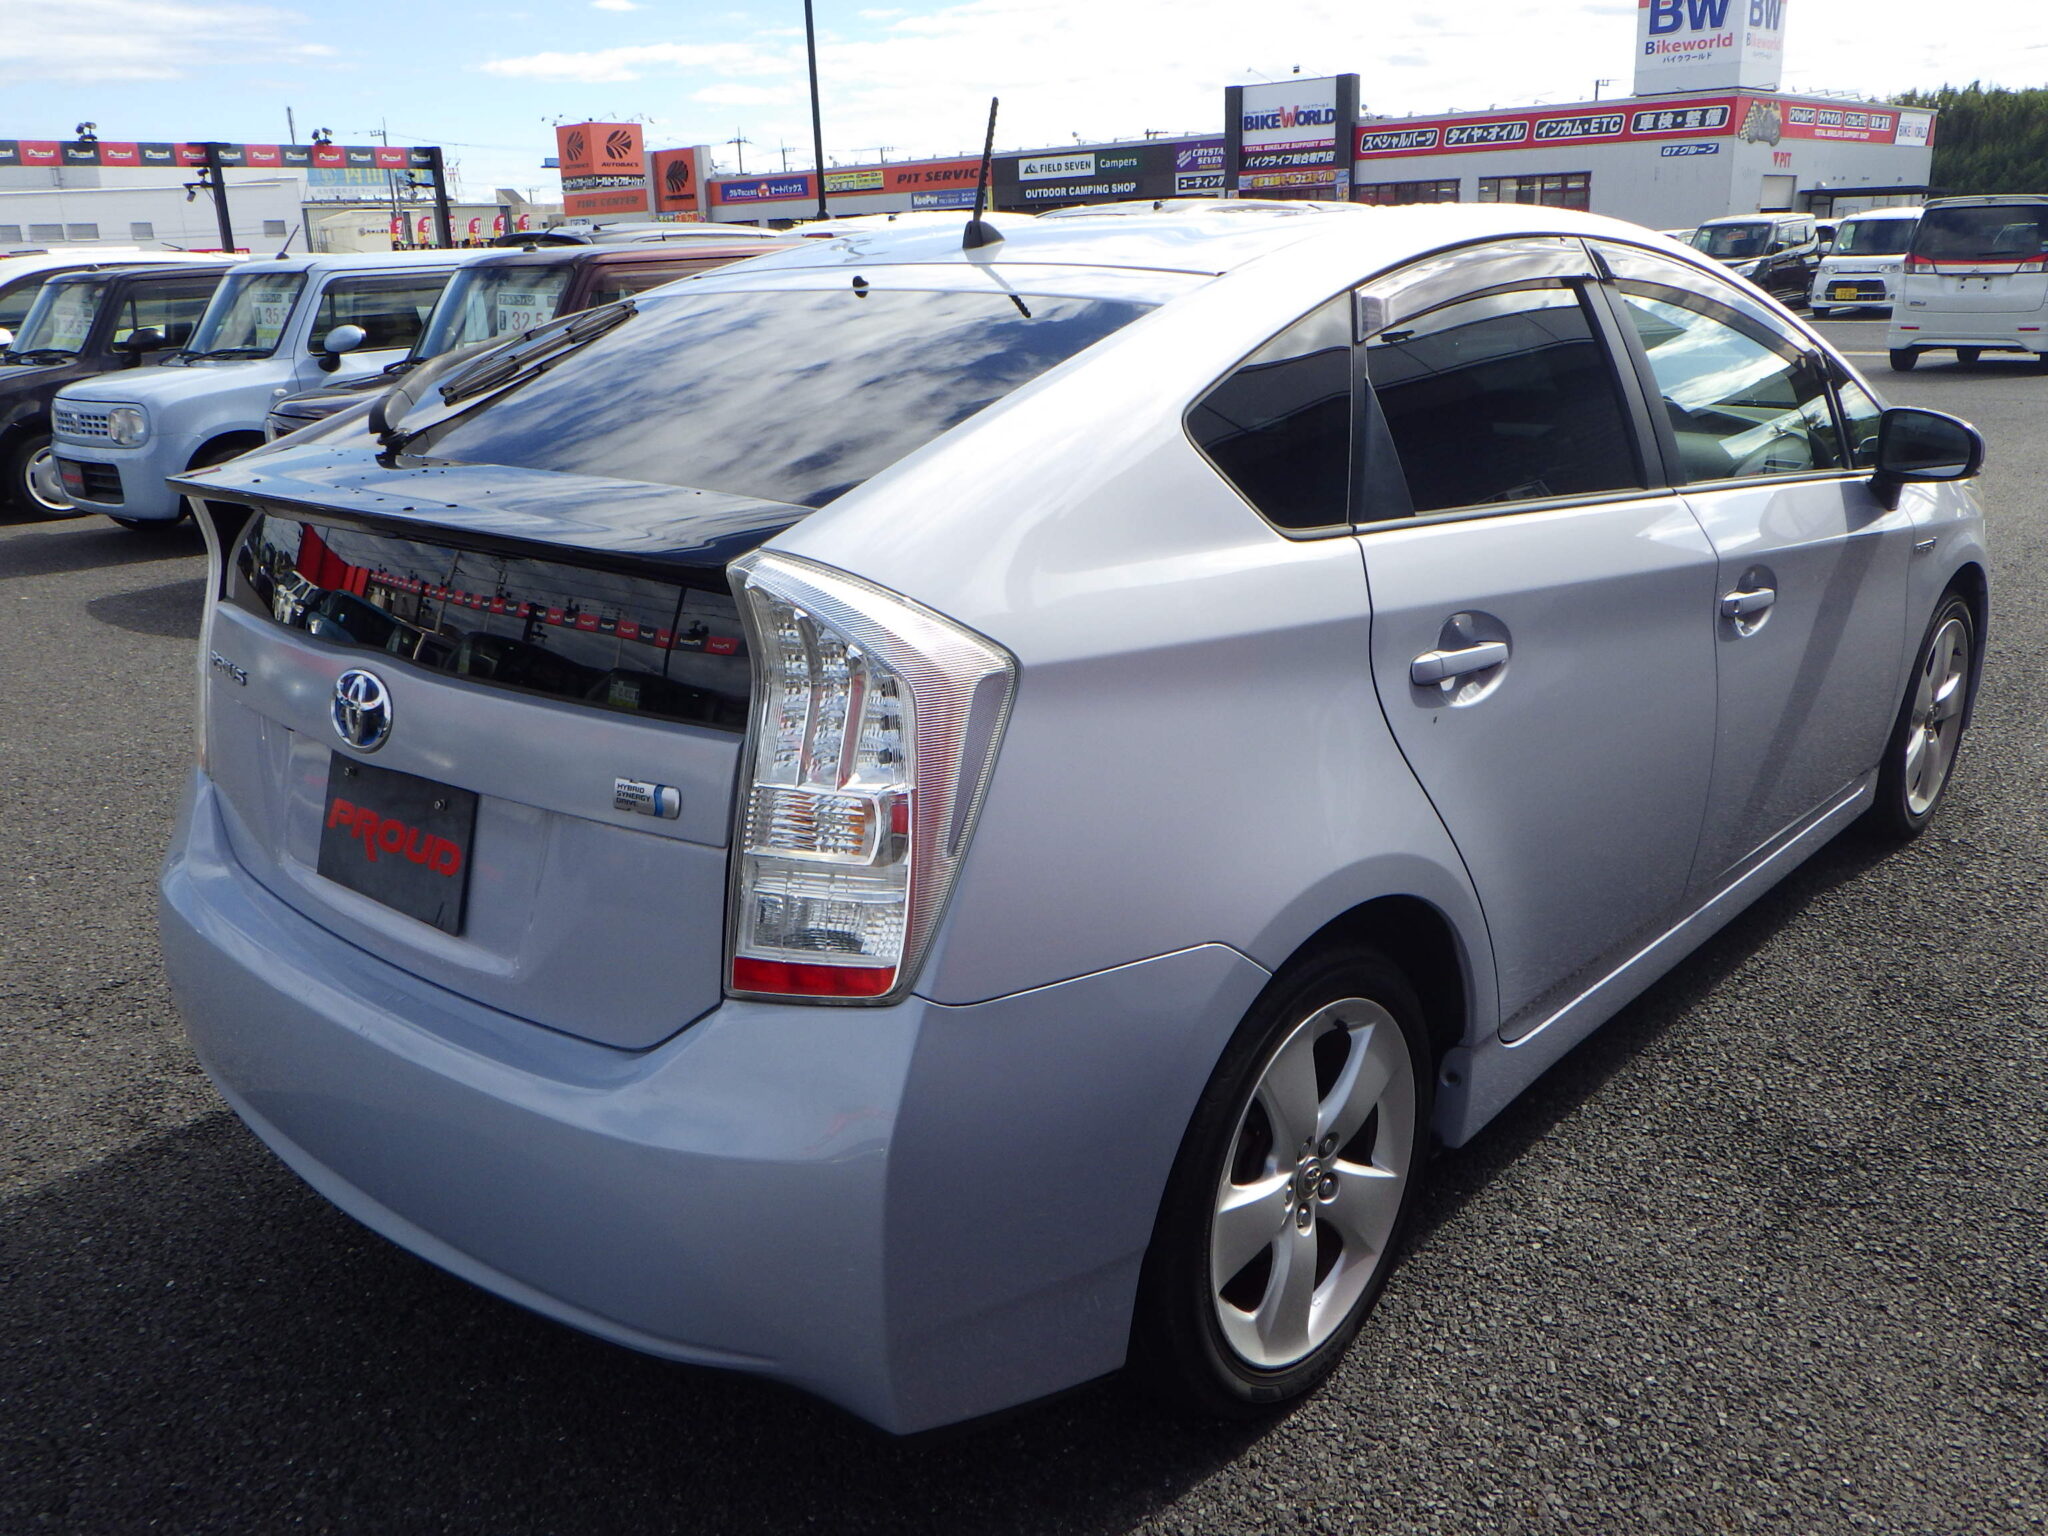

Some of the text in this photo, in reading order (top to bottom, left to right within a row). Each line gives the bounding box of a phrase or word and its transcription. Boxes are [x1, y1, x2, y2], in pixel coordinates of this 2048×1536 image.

[1649, 0, 1730, 35] BW
[1645, 32, 1733, 55] Bikeworld
[1662, 52, 1712, 64] バイクワールド
[1448, 123, 1525, 143] タイヤ・オイル
[1363, 131, 1437, 150] スペシャルパーツ
[1192, 147, 1226, 157] CRYSTA
[1040, 160, 1092, 173] FIELD SEVEN
[1099, 158, 1138, 170] Campers
[1780, 152, 1792, 168] PIT
[897, 172, 921, 184] PIT
[924, 167, 982, 183] SERVIC
[1180, 175, 1225, 188] コーティング
[1025, 182, 1136, 199] OUTDOOR CAMPING SHOP
[616, 783, 645, 794] HYBRID
[616, 790, 651, 802] SYNERGY
[616, 797, 637, 807] DRIVE
[327, 797, 462, 878] PROUD
